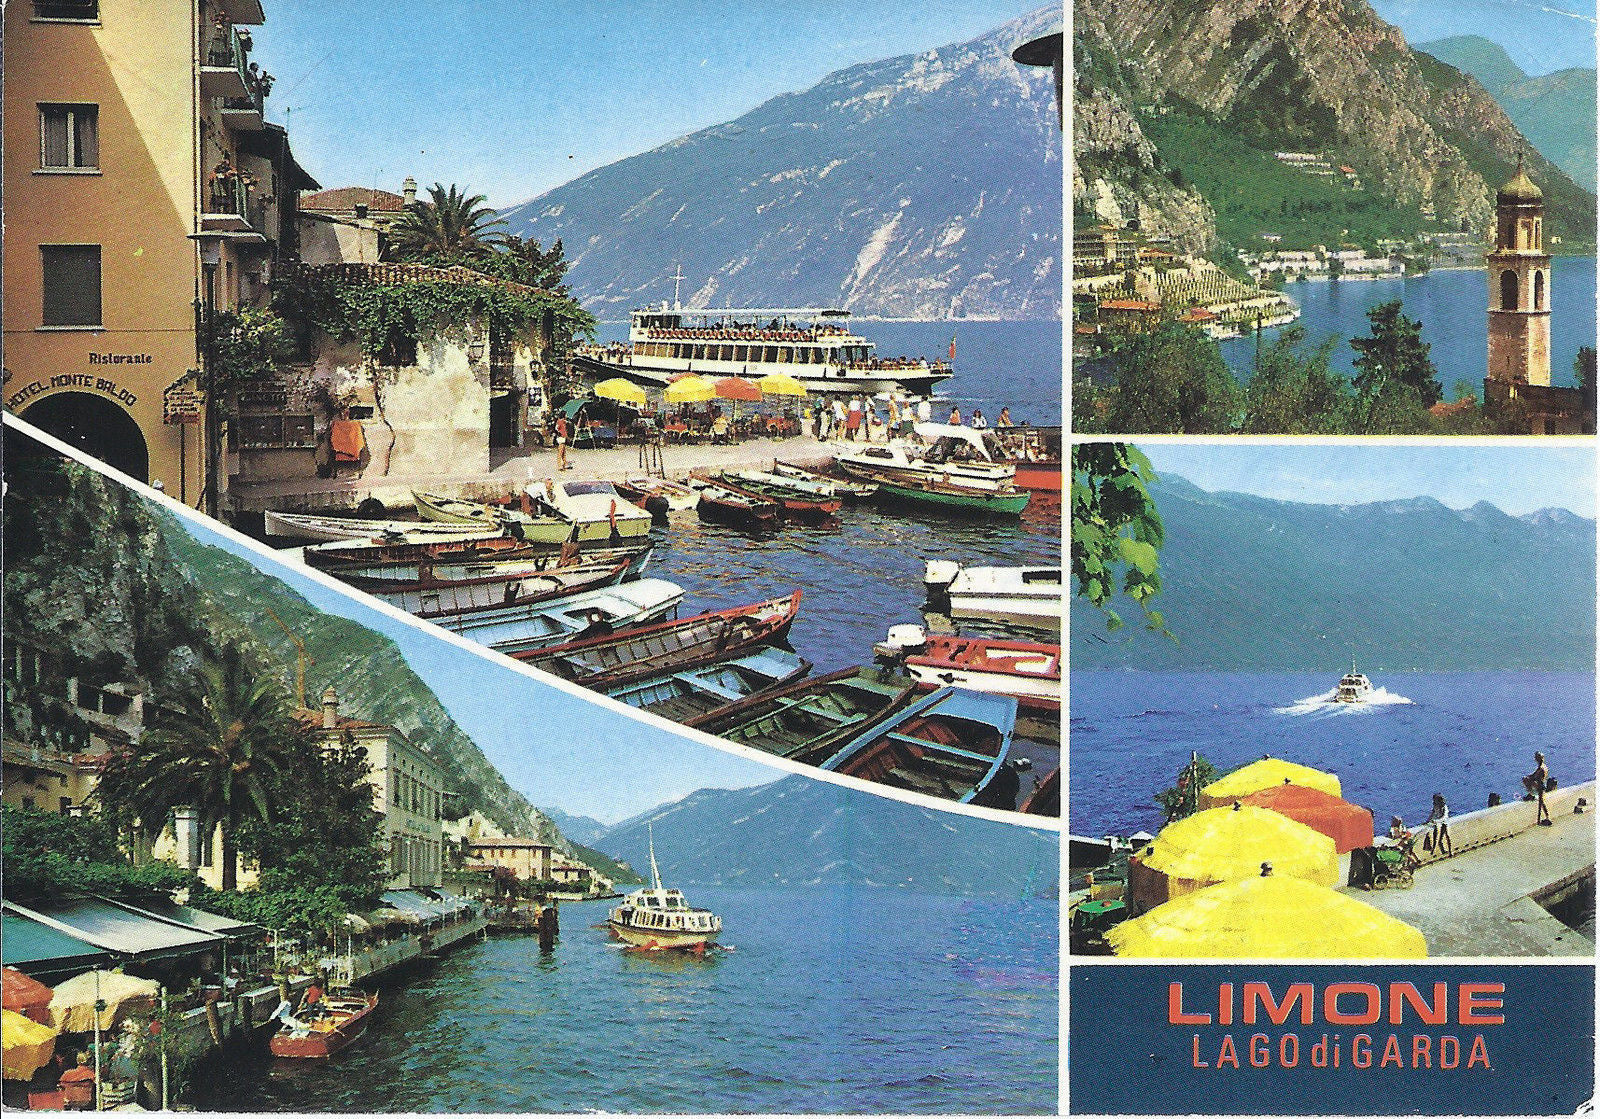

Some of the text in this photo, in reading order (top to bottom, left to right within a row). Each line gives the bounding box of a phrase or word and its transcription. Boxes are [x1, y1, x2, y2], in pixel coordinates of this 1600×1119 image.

[89, 352, 152, 364] Ristorante
[5, 375, 137, 409] HOTEL MONTE BALDO
